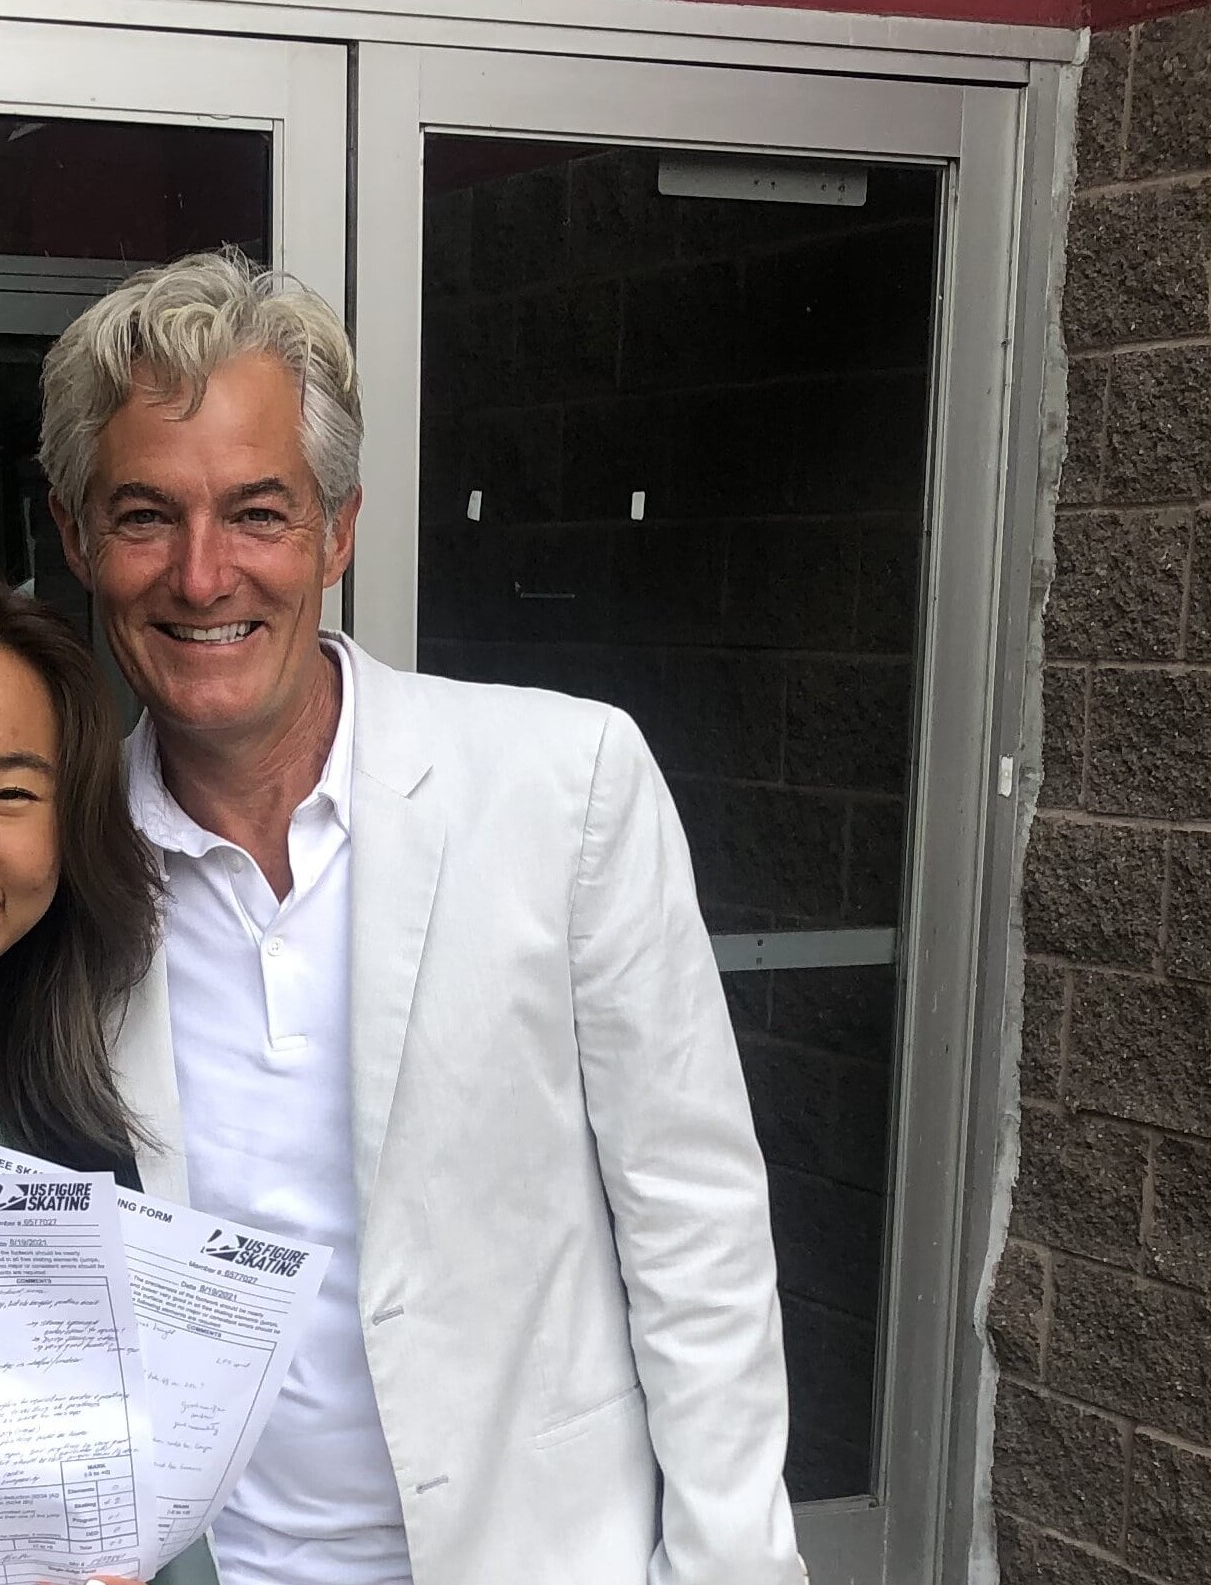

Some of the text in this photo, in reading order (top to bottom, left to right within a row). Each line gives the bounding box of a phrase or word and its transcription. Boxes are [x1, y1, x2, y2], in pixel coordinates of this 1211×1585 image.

[47, 1182, 93, 1197] FIGURE
[27, 1195, 91, 1211] SKATING
[116, 1198, 173, 1224] ING FORM
[235, 1251, 301, 1277] SKATING
[262, 1243, 310, 1265] FIGURE
[188, 1260, 217, 1274] Member
[224, 1269, 260, 1285] 6577027
[180, 1280, 197, 1291] Date
